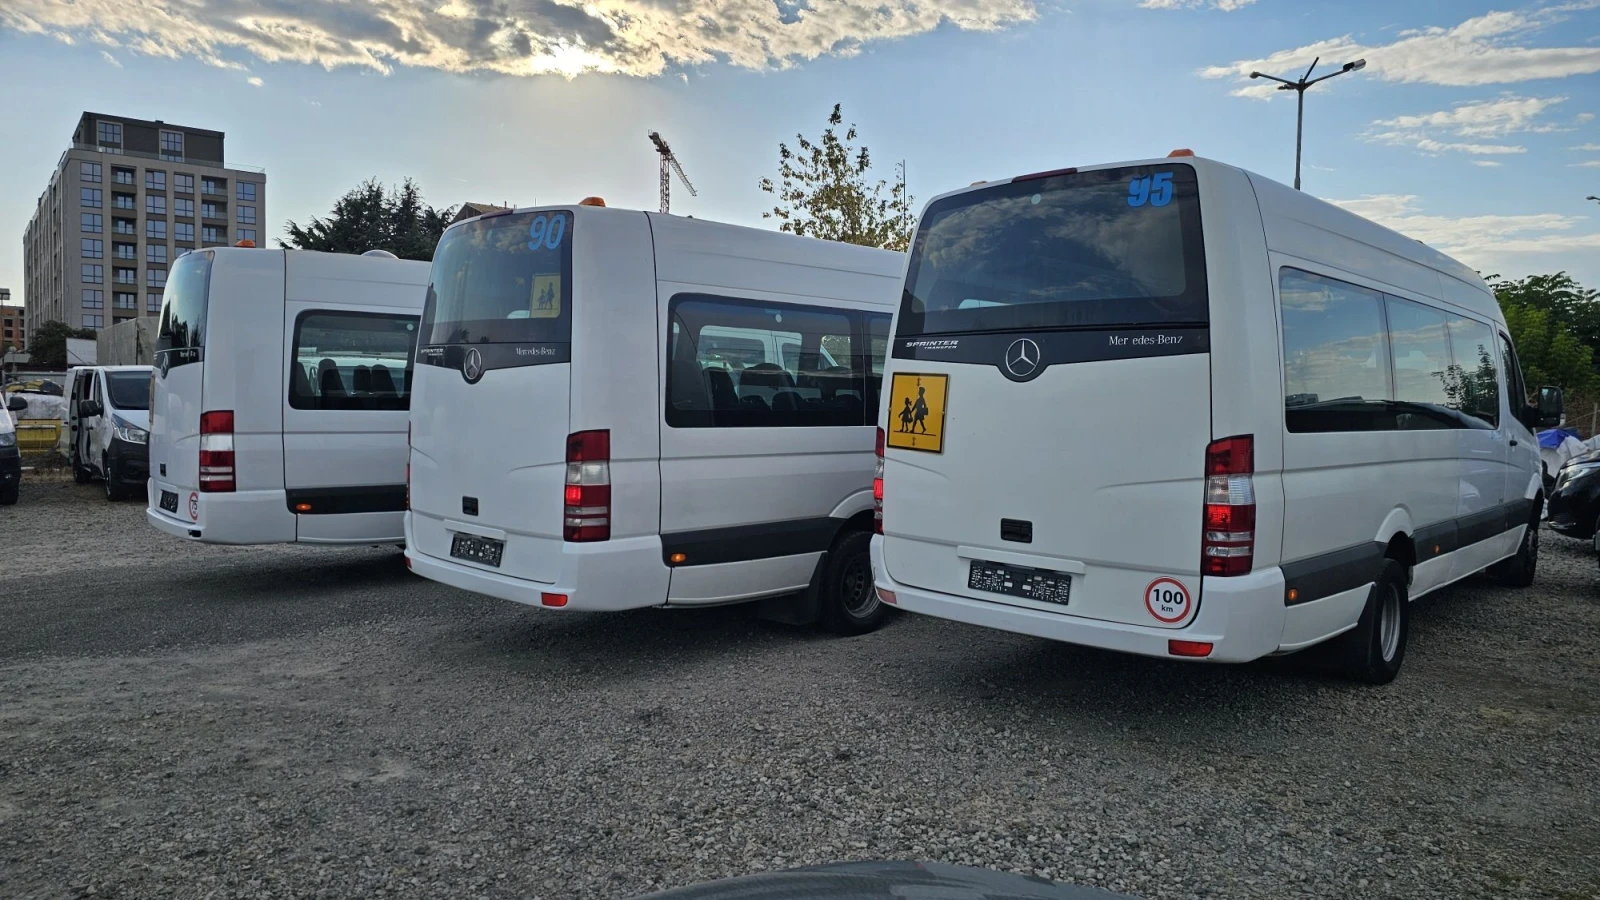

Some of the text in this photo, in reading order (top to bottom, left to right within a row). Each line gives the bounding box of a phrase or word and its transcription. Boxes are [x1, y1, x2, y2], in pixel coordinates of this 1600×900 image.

[528, 214, 566, 250] 90
[905, 340, 959, 348] SPRINTER
[1109, 334, 1183, 346] Meredes-Benz
[1153, 588, 1184, 605] 100
[1161, 604, 1174, 613] km
